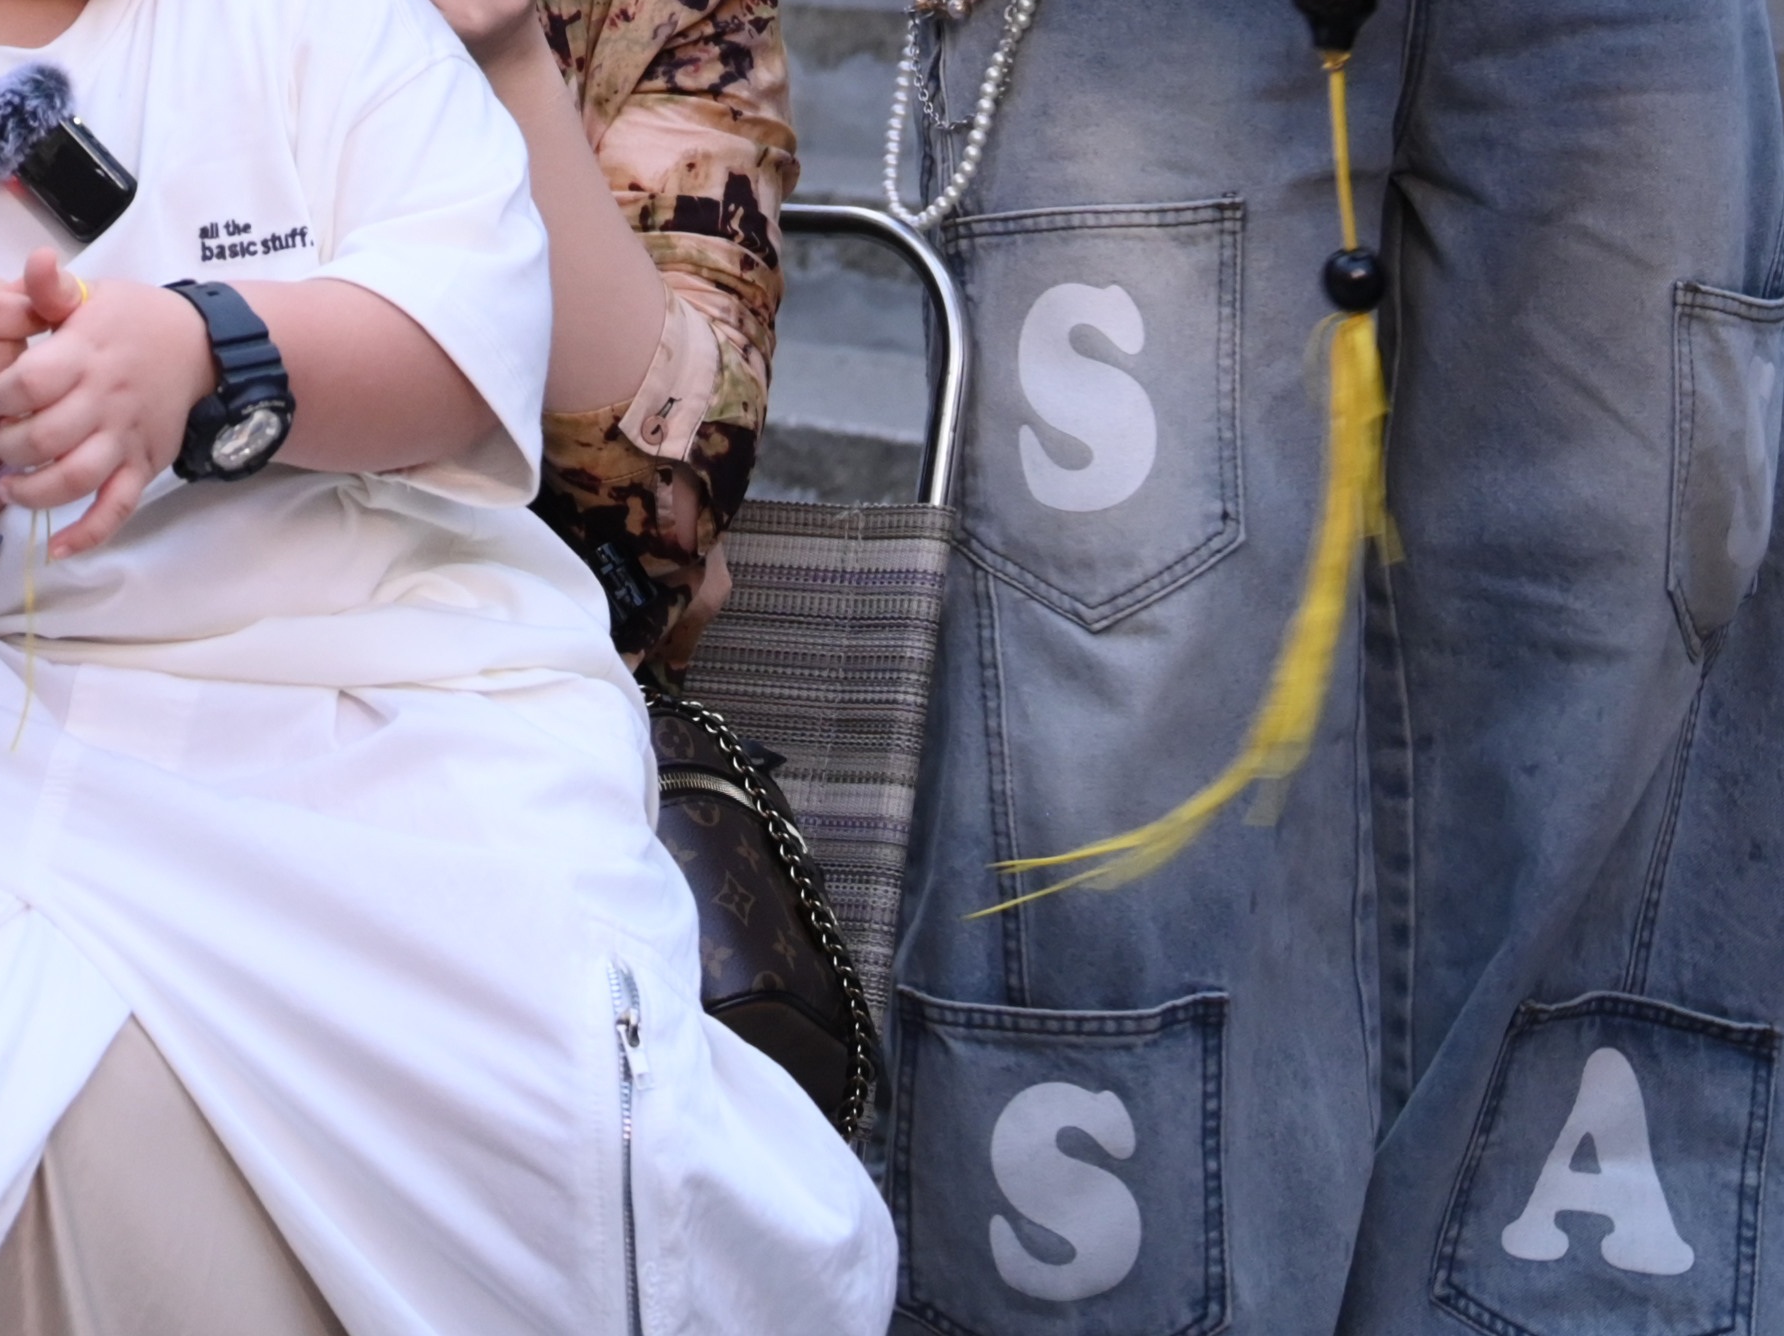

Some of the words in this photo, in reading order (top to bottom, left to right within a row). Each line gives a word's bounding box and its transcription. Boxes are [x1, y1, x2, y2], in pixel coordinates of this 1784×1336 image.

[198, 222, 219, 239] all
[223, 219, 252, 237] the
[201, 240, 258, 262] basic
[1017, 283, 1157, 512] S
[989, 1080, 1142, 1301] S
[1500, 1046, 1696, 1276] A
